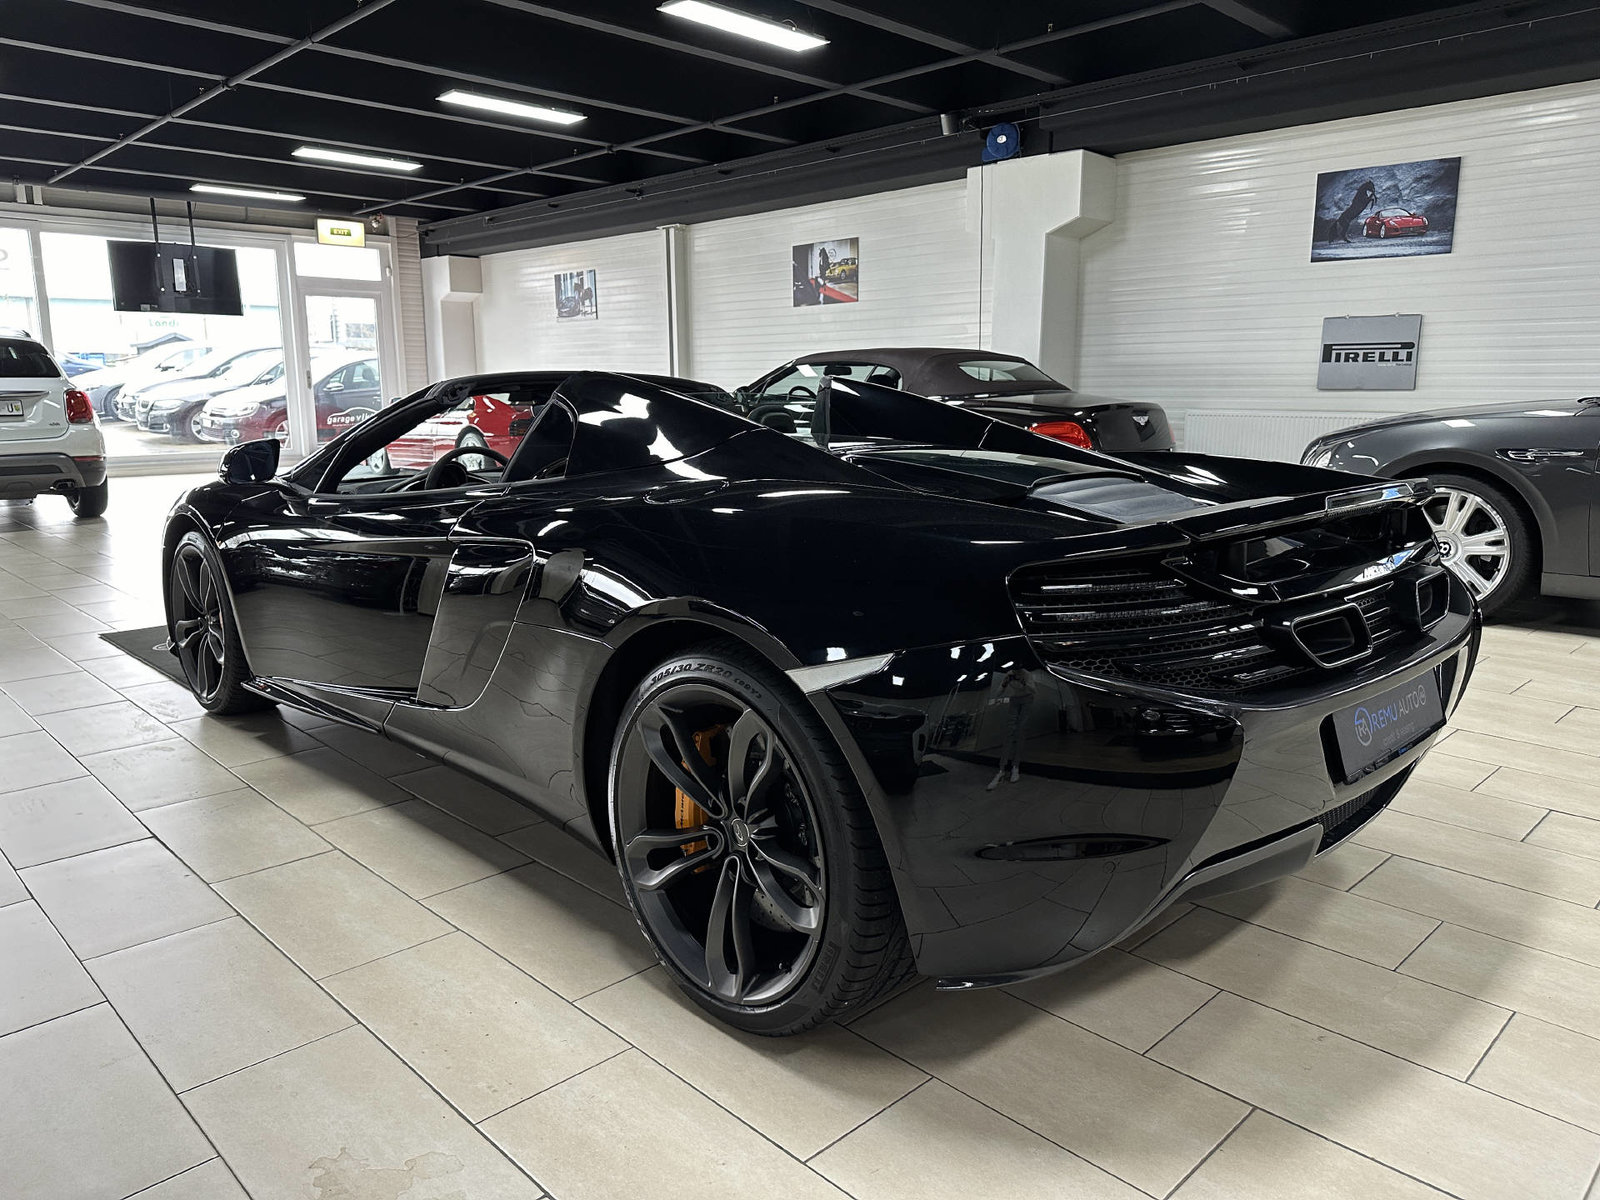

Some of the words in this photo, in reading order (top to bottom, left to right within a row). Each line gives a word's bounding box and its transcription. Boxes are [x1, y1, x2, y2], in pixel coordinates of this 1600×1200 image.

[1322, 342, 1415, 363] PIRELLI
[650, 663, 692, 687] 305/30
[693, 663, 734, 679] ZR20
[1371, 703, 1398, 732] REMU
